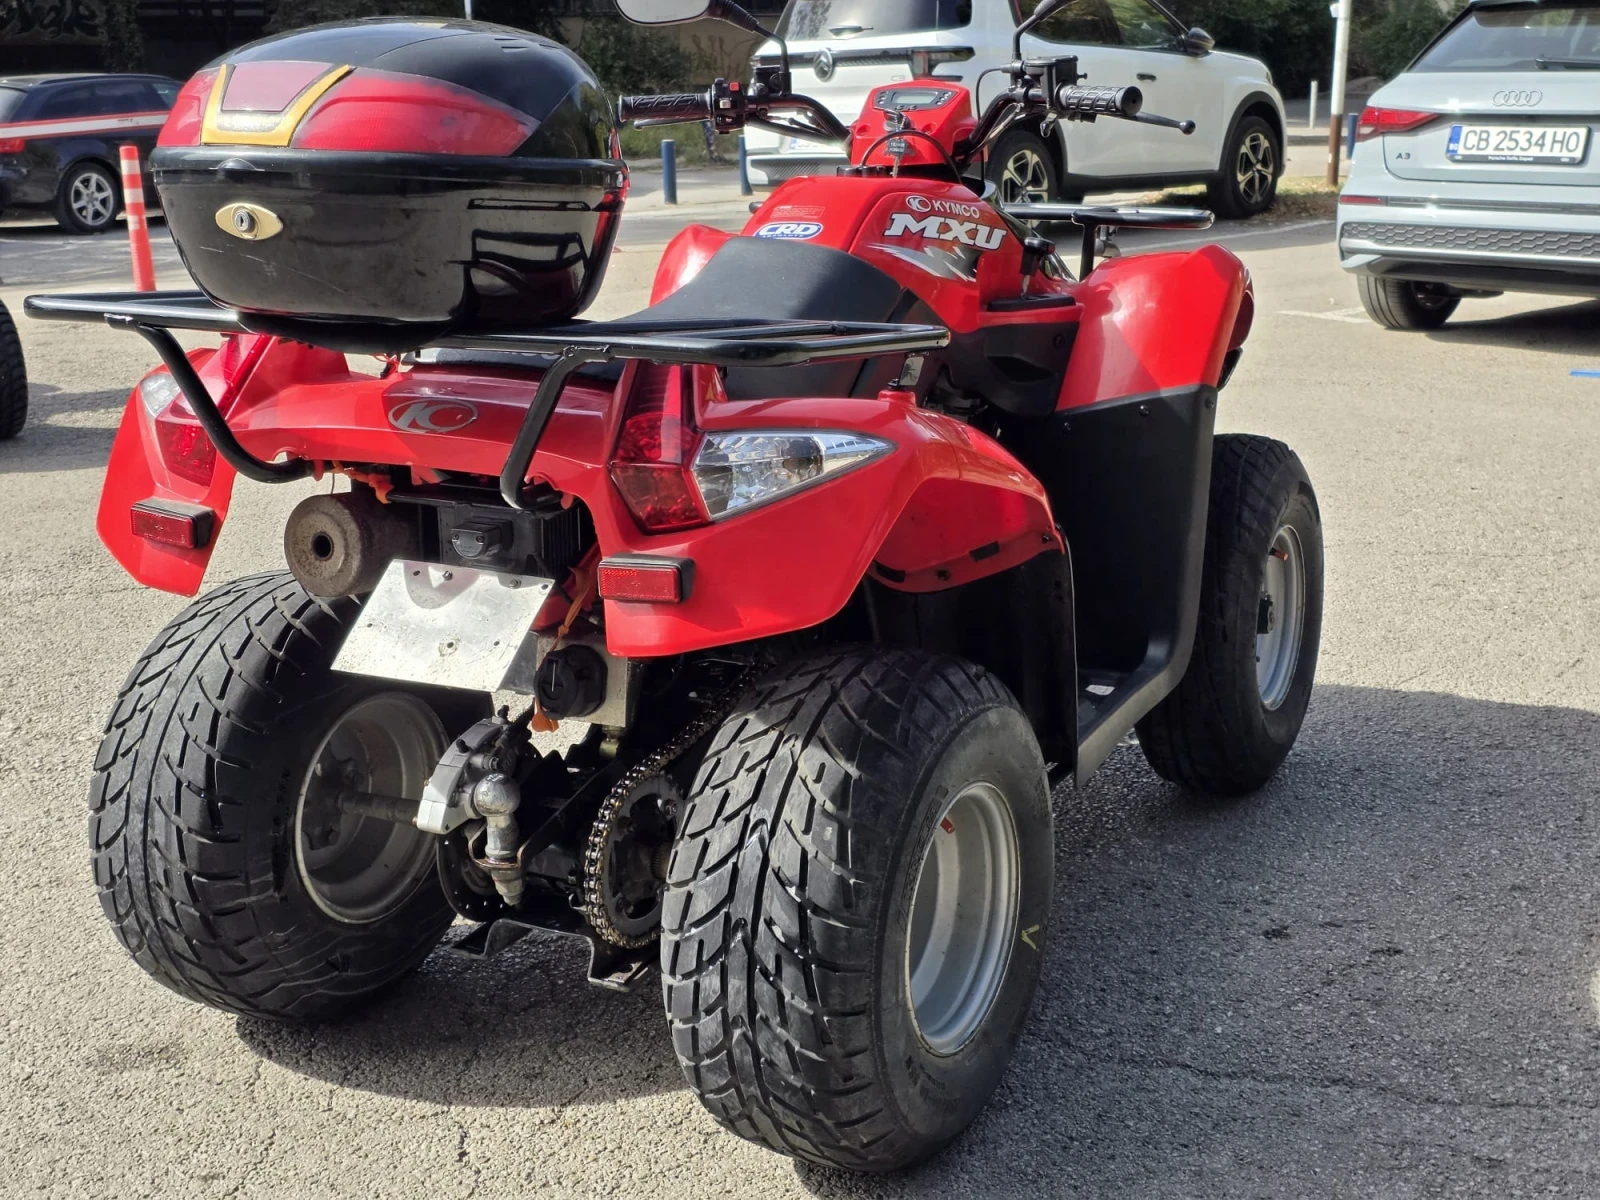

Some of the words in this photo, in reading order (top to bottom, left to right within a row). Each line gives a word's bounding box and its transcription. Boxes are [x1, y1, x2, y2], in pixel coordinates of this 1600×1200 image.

[1463, 129, 1491, 152] CB
[1492, 130, 1548, 153] 2534
[1395, 152, 1411, 160] A3
[932, 200, 980, 219] KYMCO
[758, 223, 819, 236] CRD
[883, 213, 1009, 250] MXU
